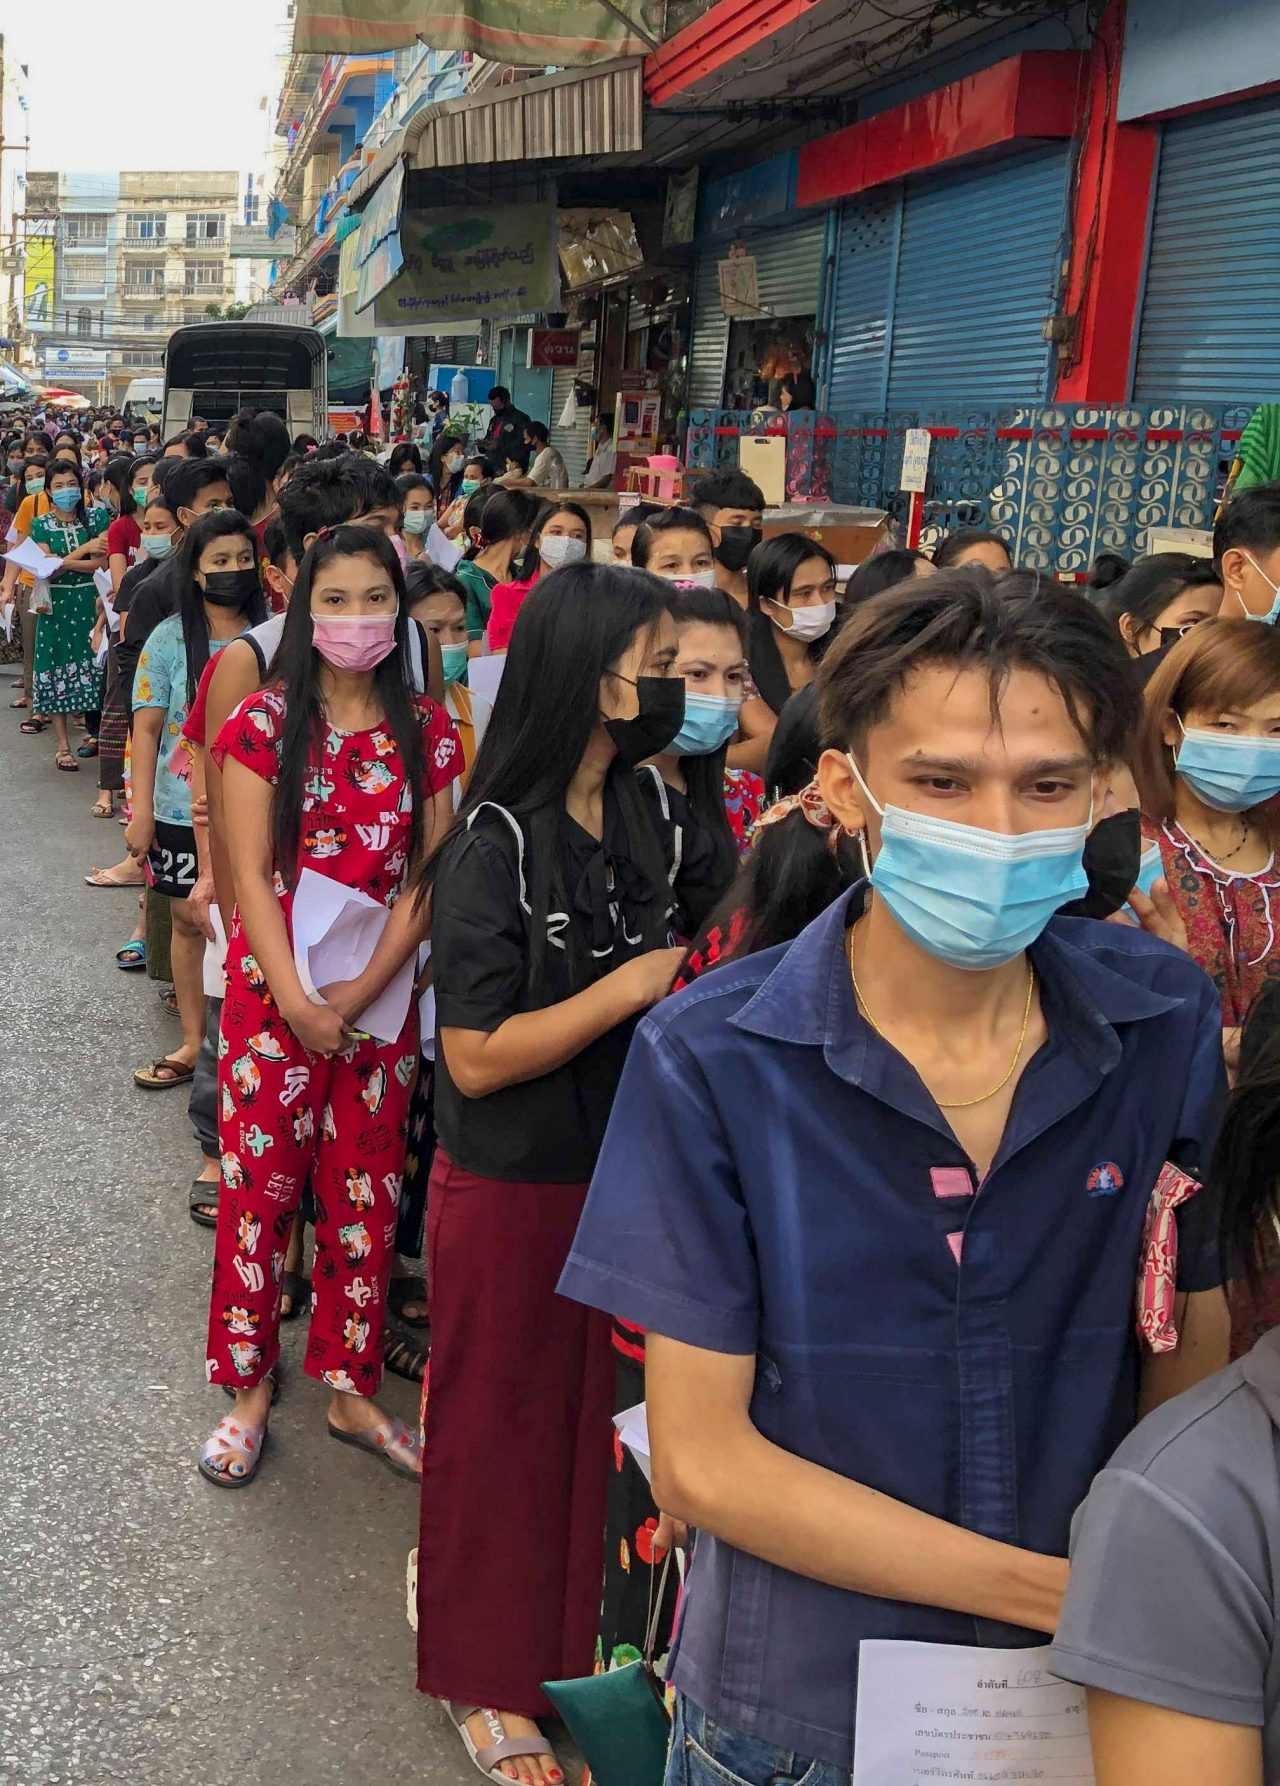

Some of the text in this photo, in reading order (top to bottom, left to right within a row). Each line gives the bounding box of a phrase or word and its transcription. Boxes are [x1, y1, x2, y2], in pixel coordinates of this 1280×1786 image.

[161, 848, 196, 885] 22
[263, 1172, 286, 1201] SET
[279, 1176, 297, 1204] SUN
